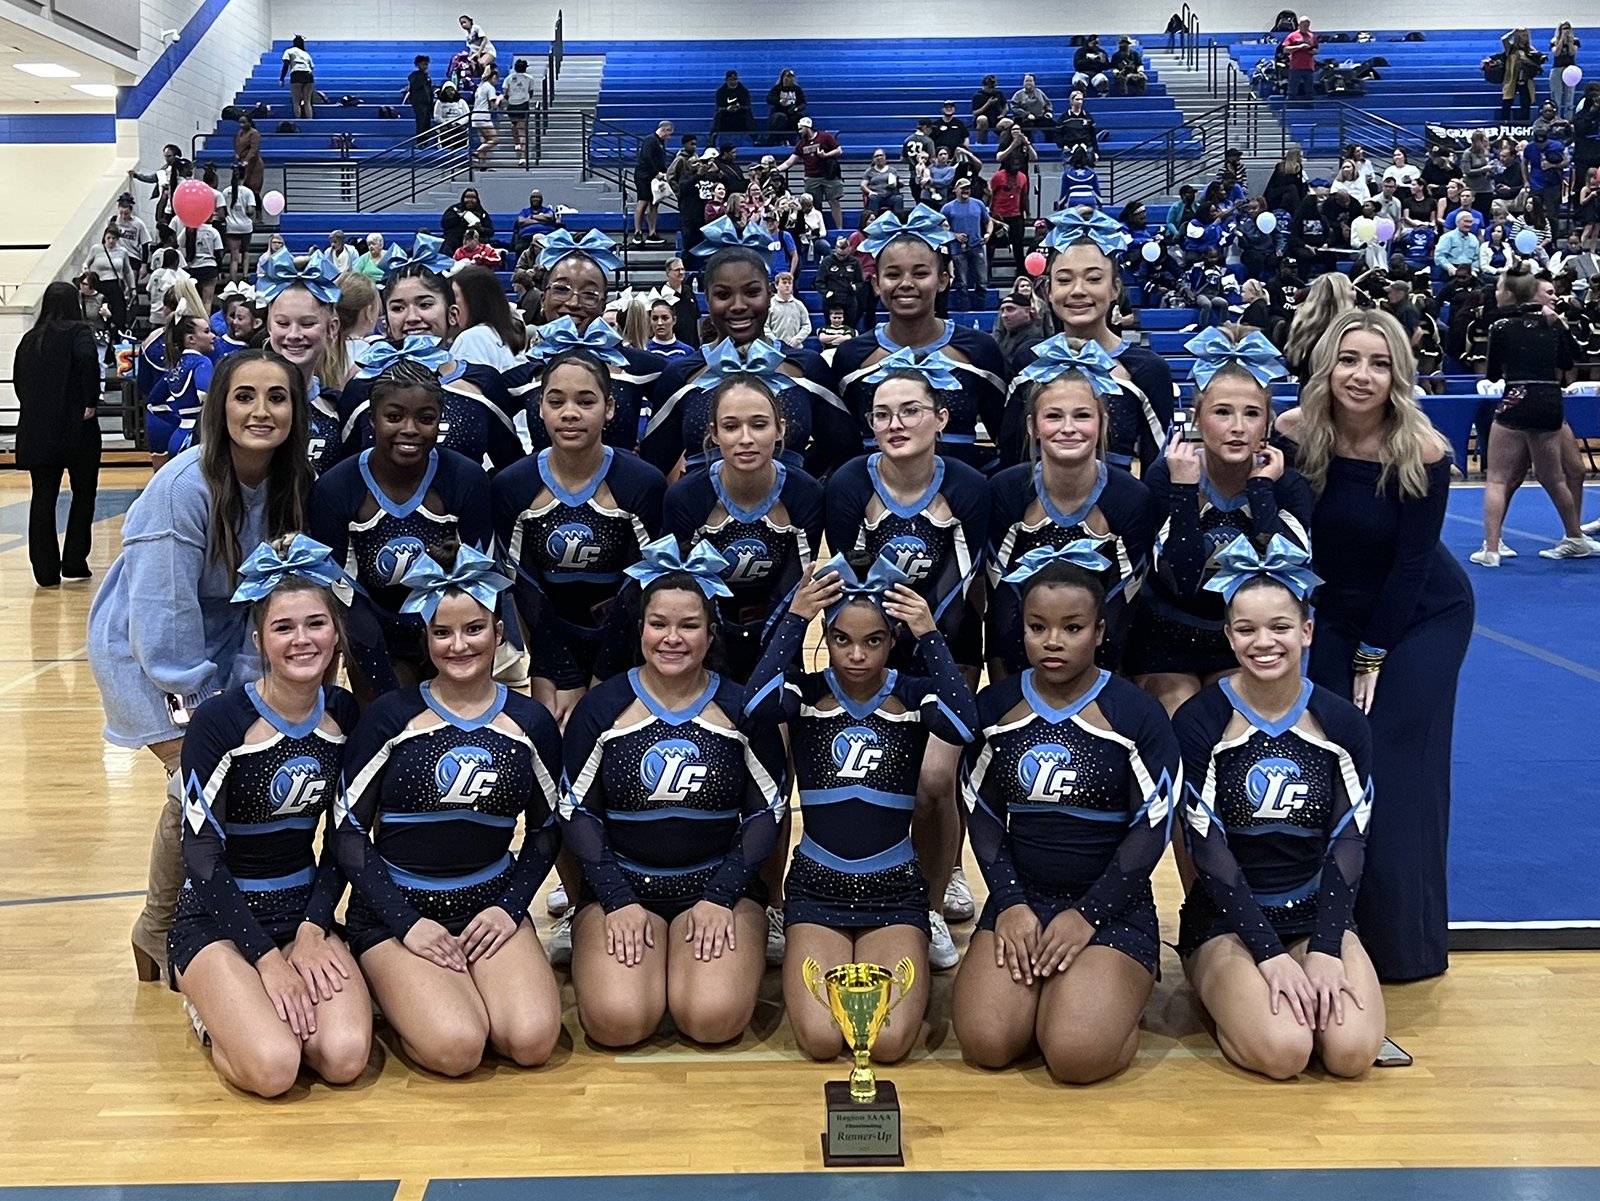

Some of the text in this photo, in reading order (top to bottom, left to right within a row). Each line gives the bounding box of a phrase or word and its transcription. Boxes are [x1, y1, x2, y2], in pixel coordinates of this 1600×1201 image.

[557, 536, 601, 569] LC
[729, 550, 773, 583] LC
[647, 753, 708, 801] LC
[836, 738, 884, 779] LC
[271, 770, 327, 815] LC
[440, 758, 498, 804] LC
[1026, 758, 1078, 803] LC
[1251, 772, 1310, 819] LC
[836, 1114, 865, 1122] Region
[837, 1131, 892, 1143] Runner-Up
